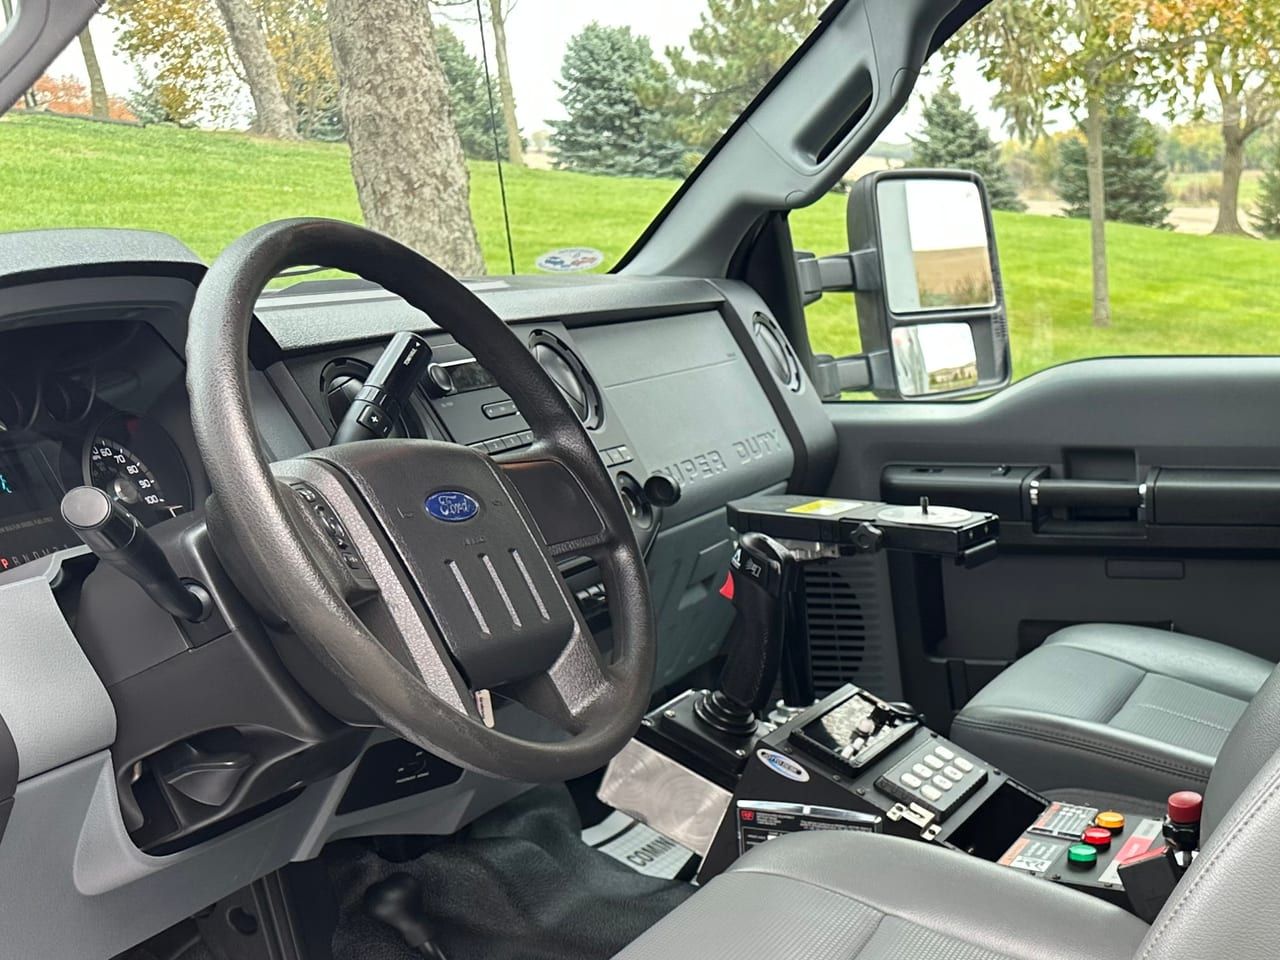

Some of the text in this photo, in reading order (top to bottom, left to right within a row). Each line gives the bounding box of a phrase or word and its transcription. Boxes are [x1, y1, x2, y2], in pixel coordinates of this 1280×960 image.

[731, 428, 782, 465] DUTY
[100, 447, 113, 457] 60
[113, 454, 126, 464] 70
[126, 465, 139, 475] 80
[138, 479, 151, 489] 90
[144, 494, 159, 505] 100
[438, 494, 472, 517] Ford
[1, 557, 9, 569] P
[12, 556, 21, 566] R
